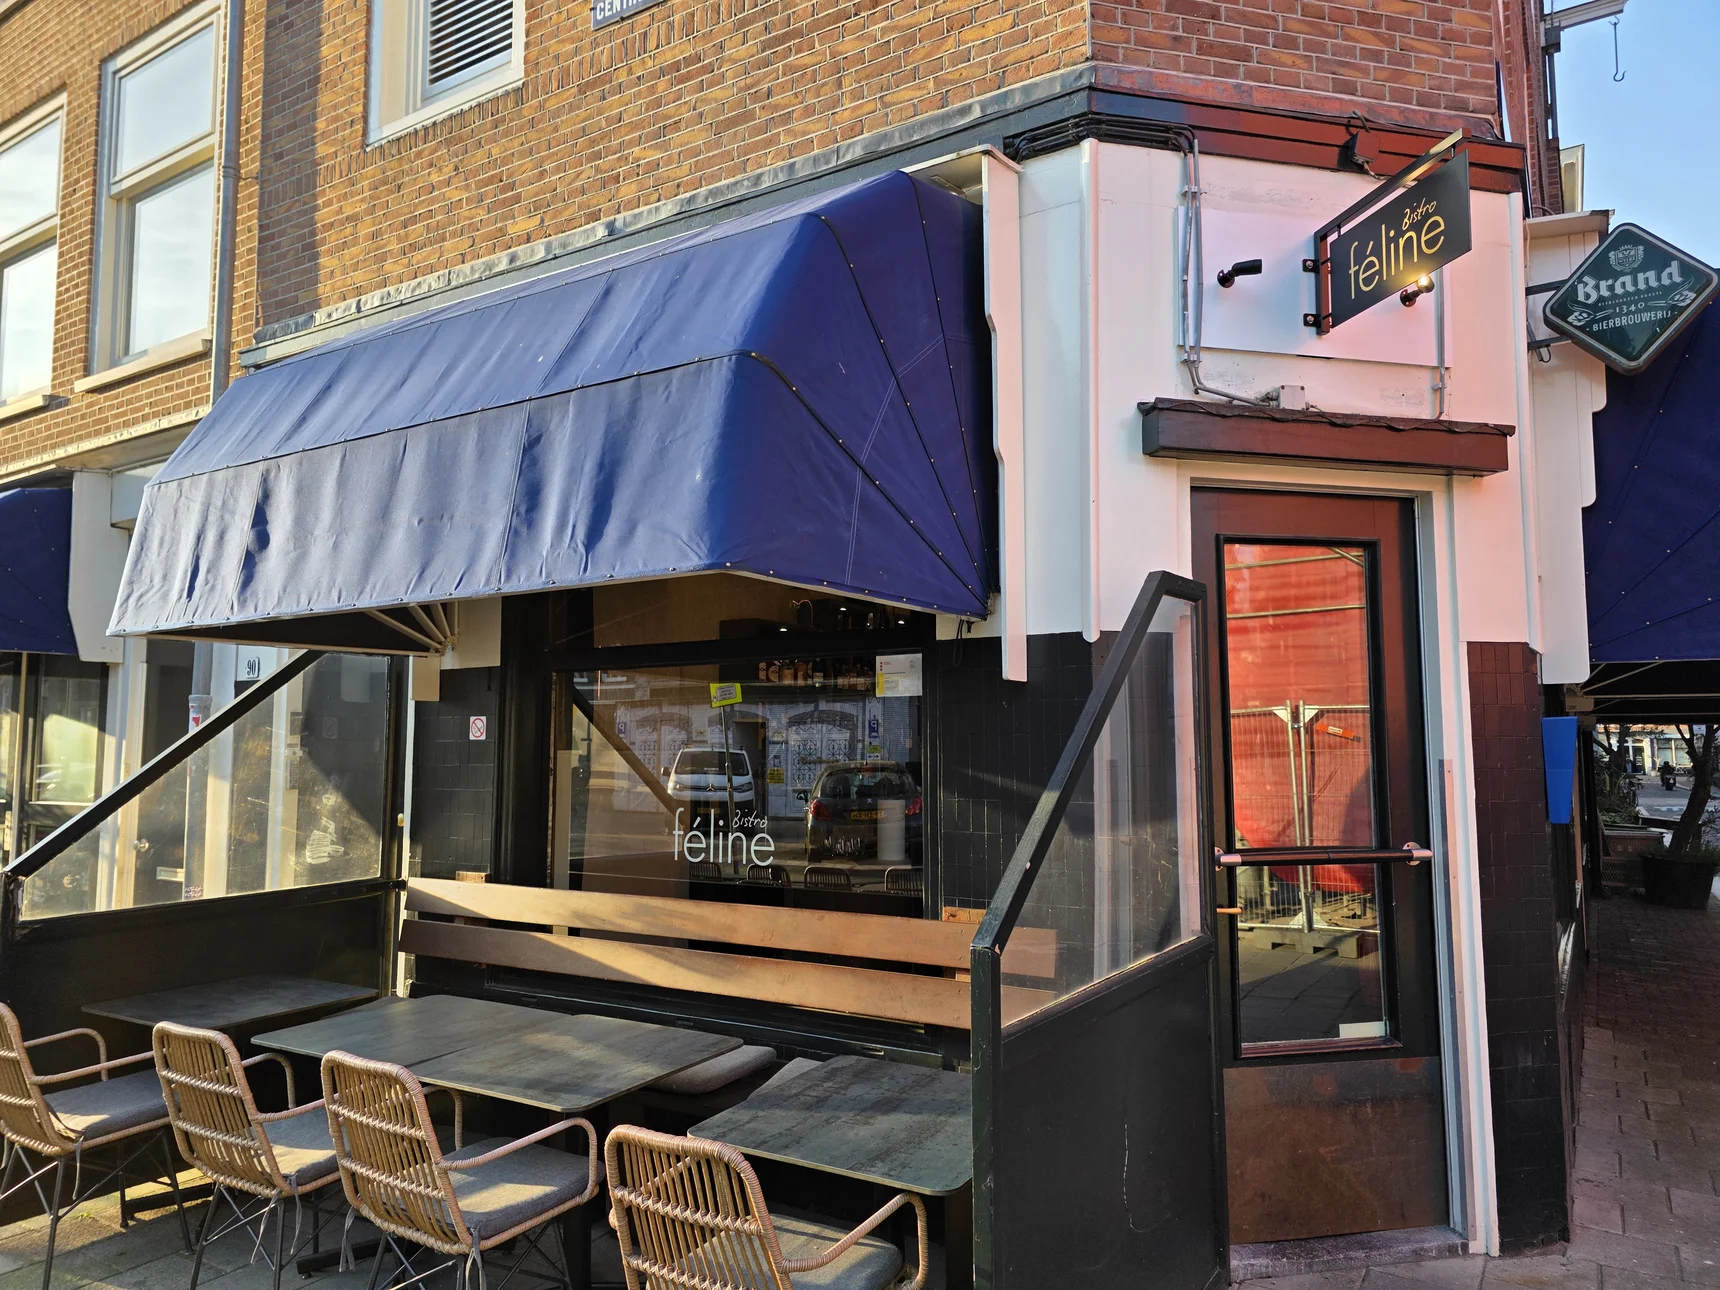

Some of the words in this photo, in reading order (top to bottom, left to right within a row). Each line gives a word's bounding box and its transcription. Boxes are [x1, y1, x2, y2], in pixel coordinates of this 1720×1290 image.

[1402, 197, 1437, 231] Bistro
[1349, 215, 1445, 300] féline
[1577, 260, 1684, 304] Brand
[1592, 310, 1671, 331] BIERBROUWERIJ
[1616, 302, 1645, 313] 1340
[246, 659, 257, 676] 90
[732, 809, 768, 828] Bistro
[672, 807, 775, 867] féline
